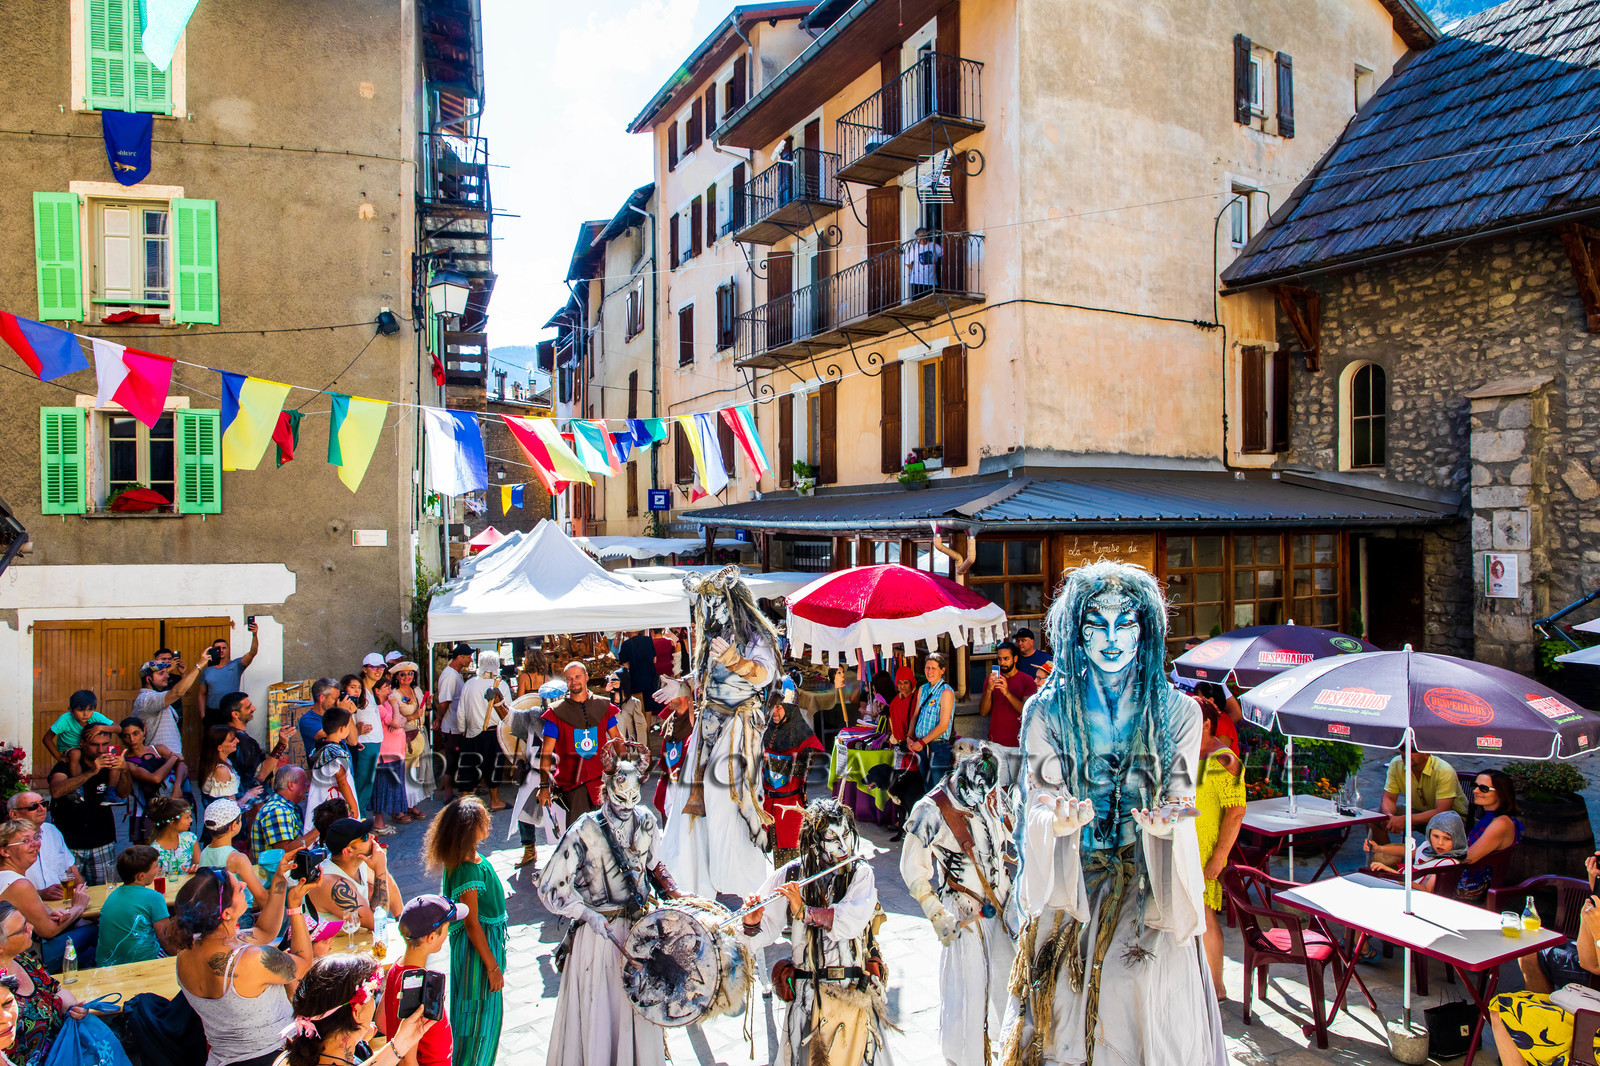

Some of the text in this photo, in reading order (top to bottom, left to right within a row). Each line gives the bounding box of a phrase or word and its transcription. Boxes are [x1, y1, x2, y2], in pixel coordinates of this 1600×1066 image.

[1068, 537, 1081, 556] La
[1128, 542, 1138, 553] du
[403, 622, 409, 630] 6
[1259, 652, 1313, 664] DESPERADOS
[1315, 689, 1391, 710] DESPERADOS
[1430, 696, 1488, 717] DESPERADOS
